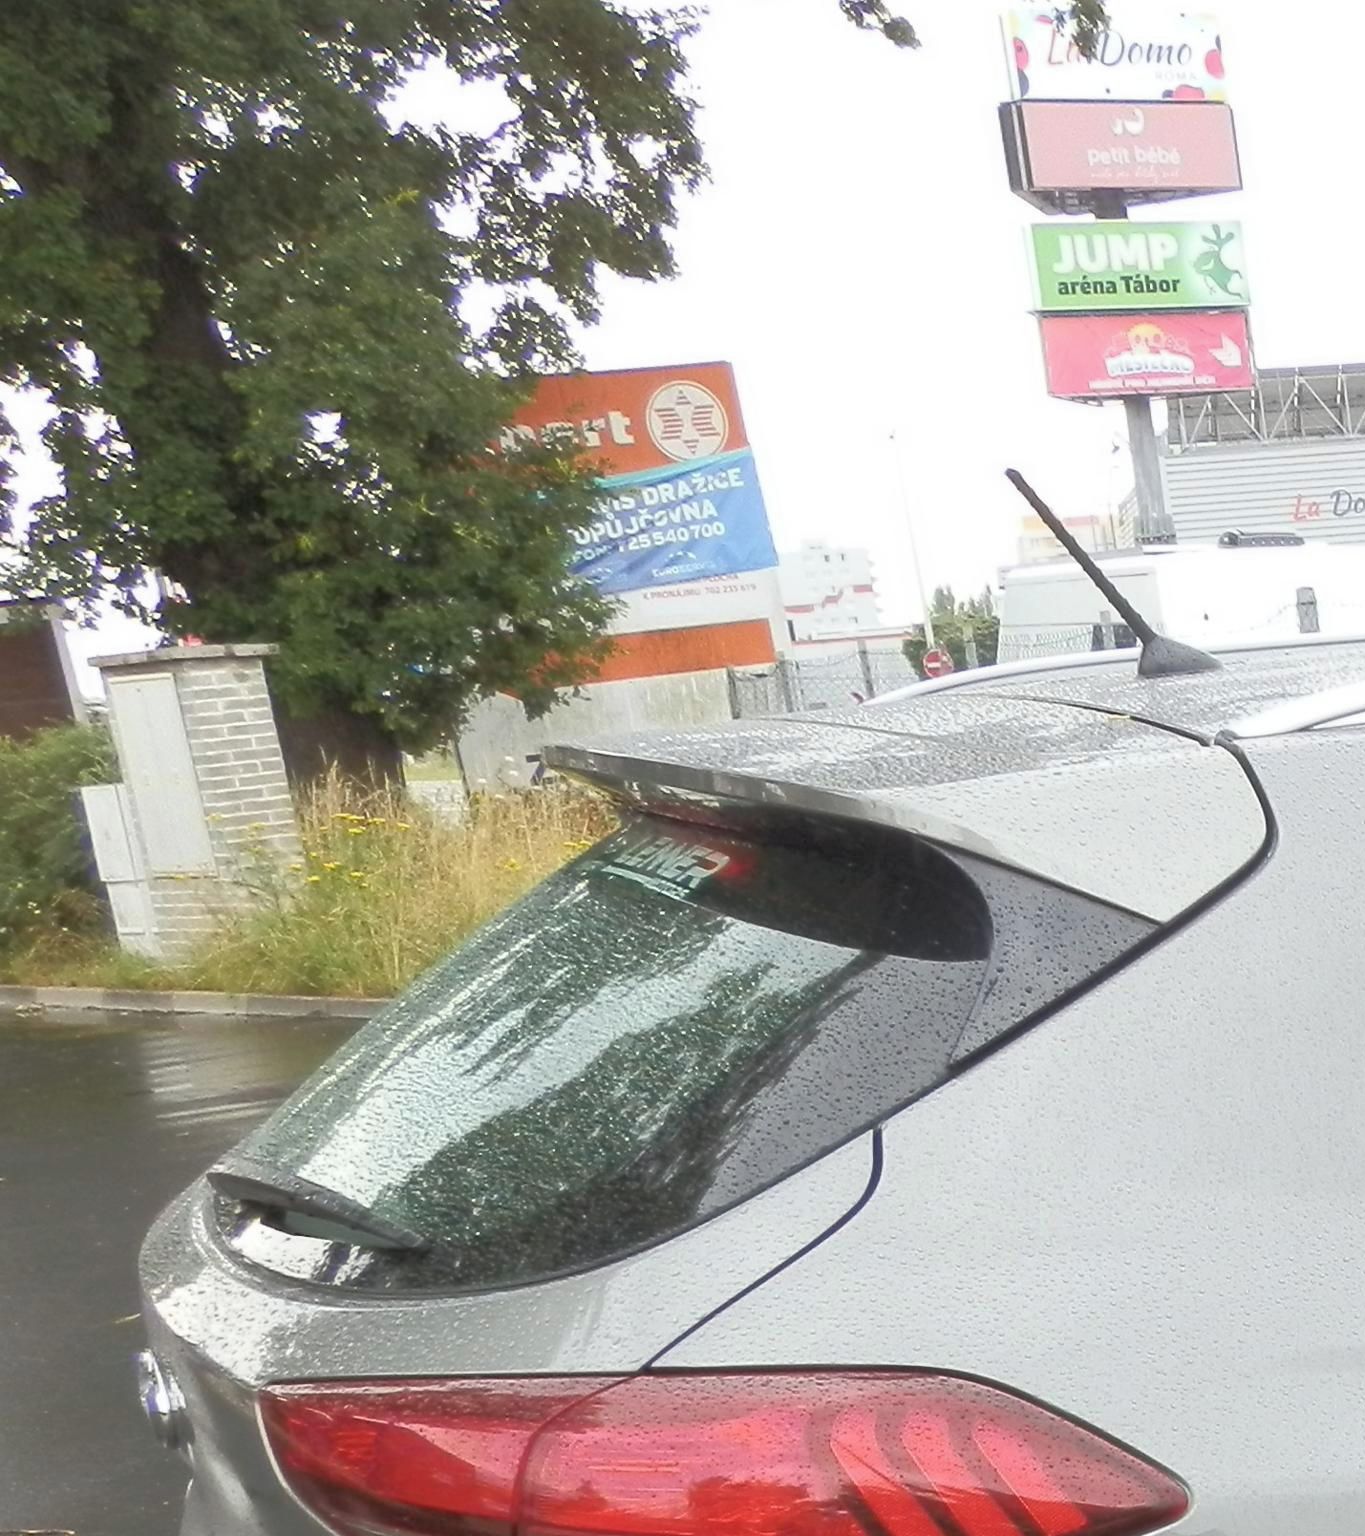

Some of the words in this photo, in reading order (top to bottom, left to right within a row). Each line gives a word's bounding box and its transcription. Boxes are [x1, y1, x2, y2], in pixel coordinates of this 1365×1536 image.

[1099, 30, 1192, 66] Domo
[1053, 232, 1179, 274] JUMP
[1058, 276, 1117, 296] aréna
[1124, 275, 1180, 294] Tábor
[641, 468, 745, 505] DRAŽICE
[1293, 494, 1320, 521] La
